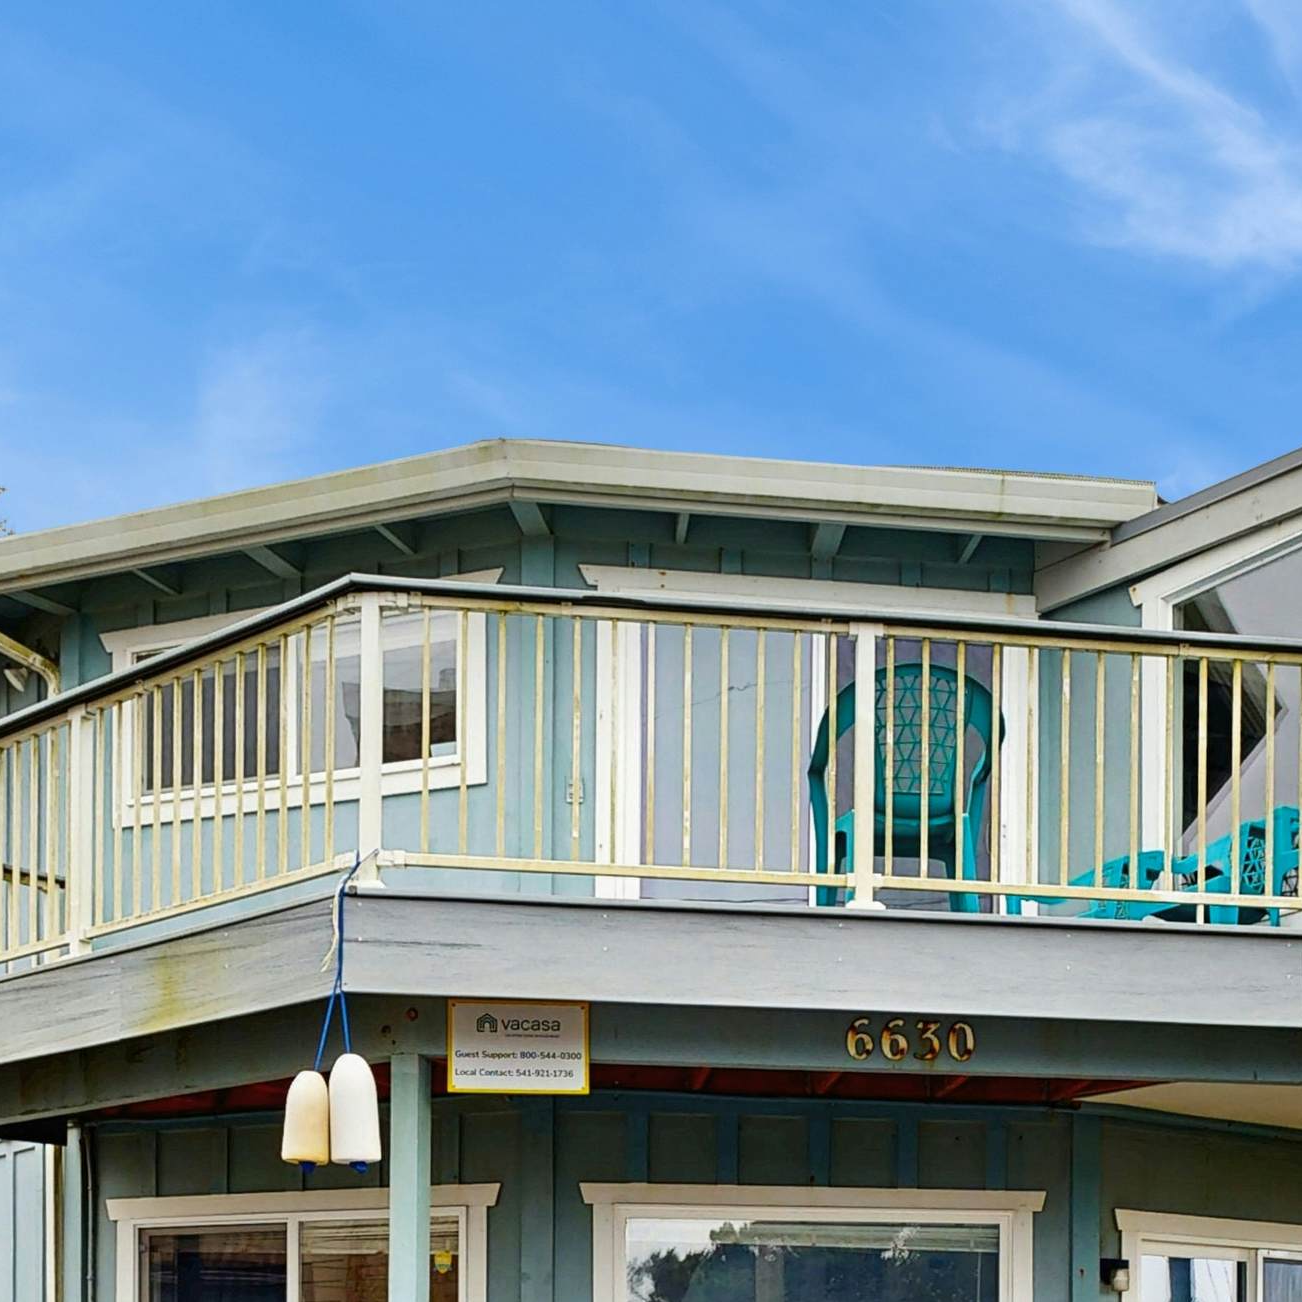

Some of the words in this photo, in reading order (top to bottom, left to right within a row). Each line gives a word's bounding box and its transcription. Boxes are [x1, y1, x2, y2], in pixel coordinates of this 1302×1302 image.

[501, 1018, 561, 1032] vacasa
[846, 1016, 976, 1062] 6630
[455, 1050, 479, 1058] Guest
[482, 1050, 518, 1060] Support:
[520, 1051, 582, 1060] 800-544-0300
[455, 1068, 476, 1076] Local
[479, 1068, 514, 1077] Contact:
[515, 1069, 574, 1078] 541-921-1736
